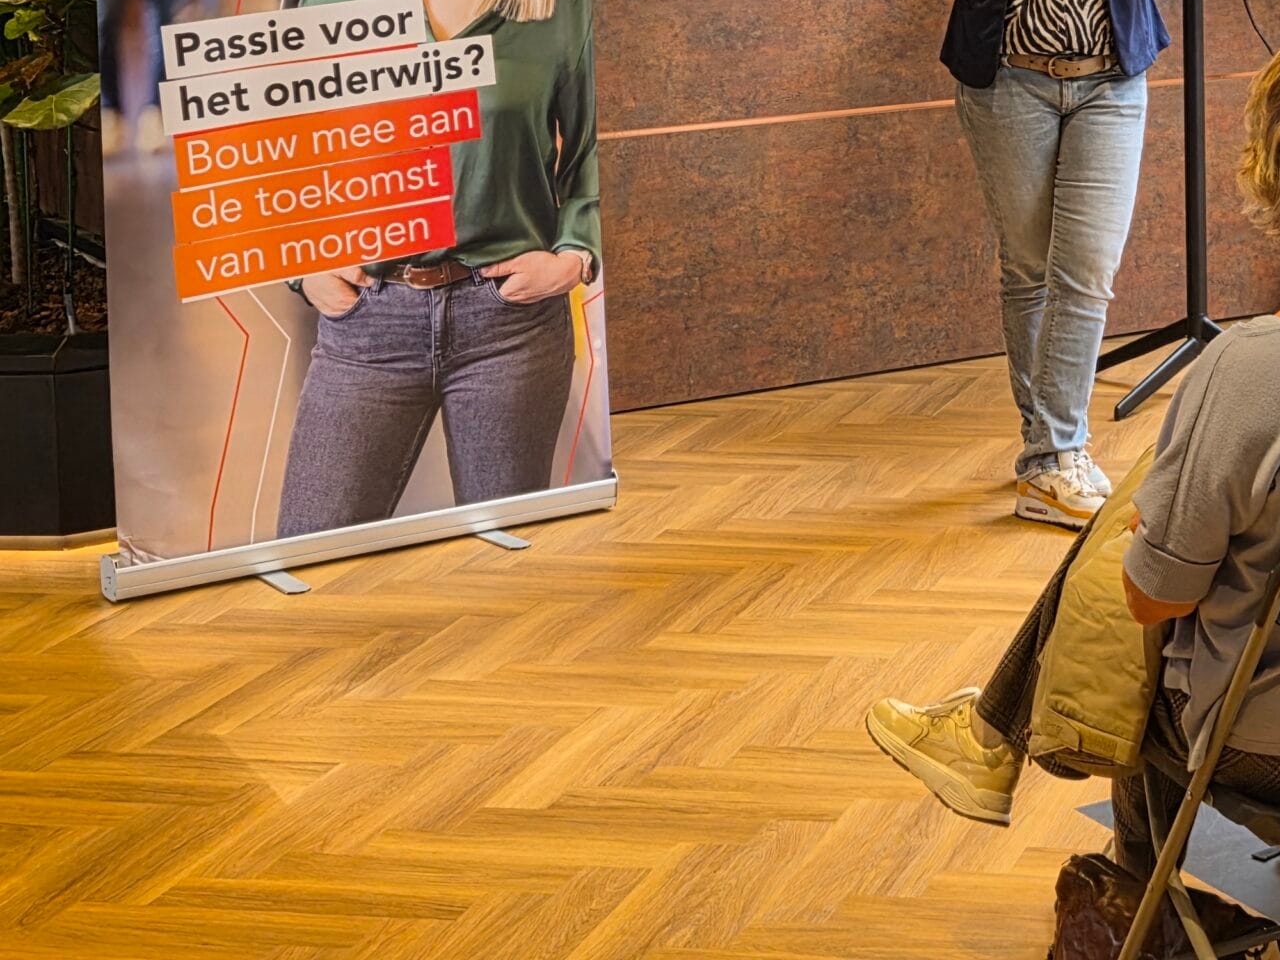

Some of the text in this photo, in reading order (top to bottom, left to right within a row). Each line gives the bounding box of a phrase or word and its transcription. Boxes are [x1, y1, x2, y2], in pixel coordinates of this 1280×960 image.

[173, 9, 414, 67] Passie voor
[179, 43, 485, 122] het onderwijs?
[186, 106, 474, 176] Bouw mee aan
[192, 159, 440, 229] de toekomst
[196, 216, 430, 282] van morgen
